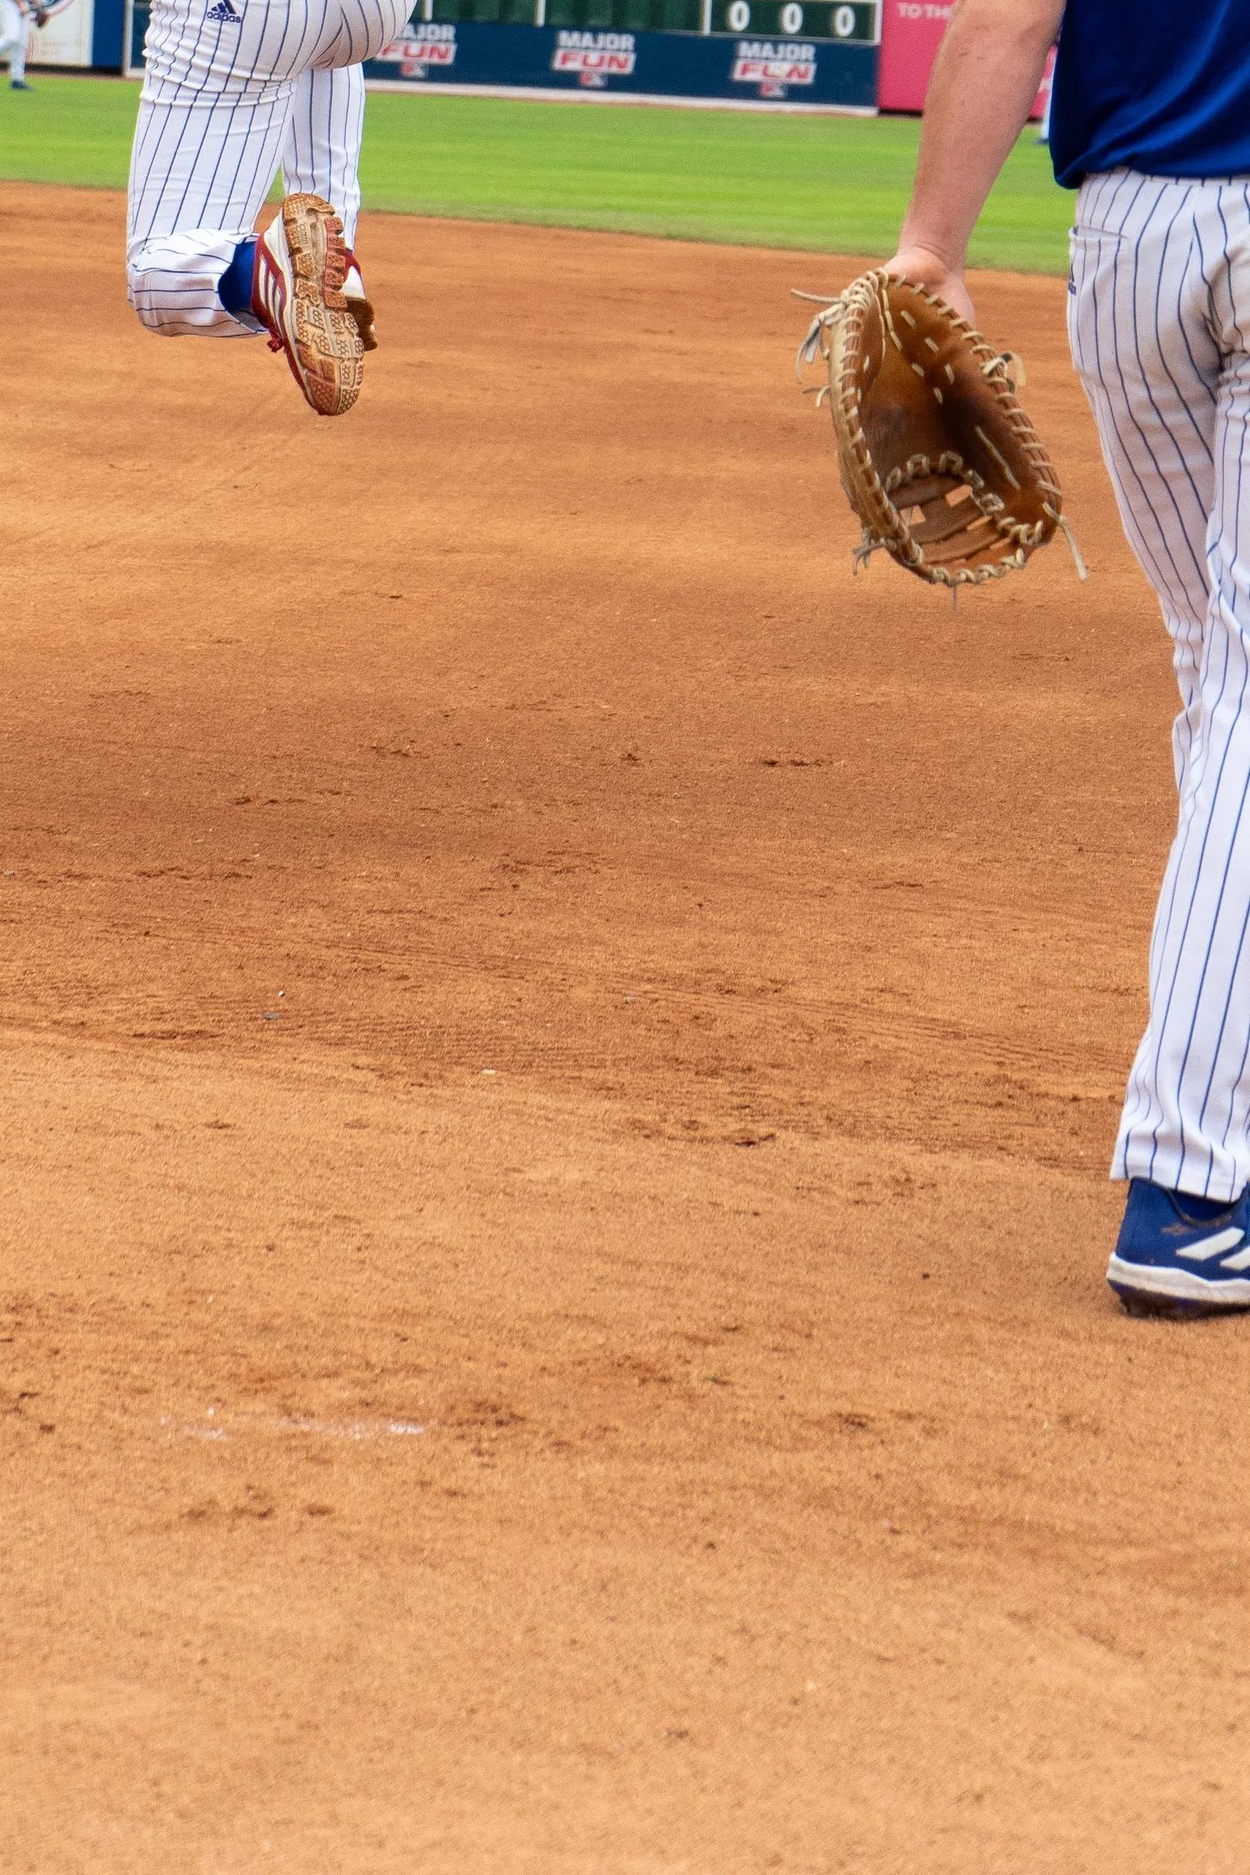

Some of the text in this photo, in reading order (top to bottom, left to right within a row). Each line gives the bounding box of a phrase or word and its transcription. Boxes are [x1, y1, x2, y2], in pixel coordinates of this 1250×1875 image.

[207, 10, 242, 23] adidas
[728, 0, 856, 37] 0 0 0
[897, 2, 923, 19] TO
[398, 23, 456, 42] AJOR
[558, 29, 636, 51] MAJOR
[381, 43, 451, 61] FUN
[561, 50, 630, 70] FUN
[739, 41, 816, 62] MAJOR
[741, 63, 812, 81] FUN
